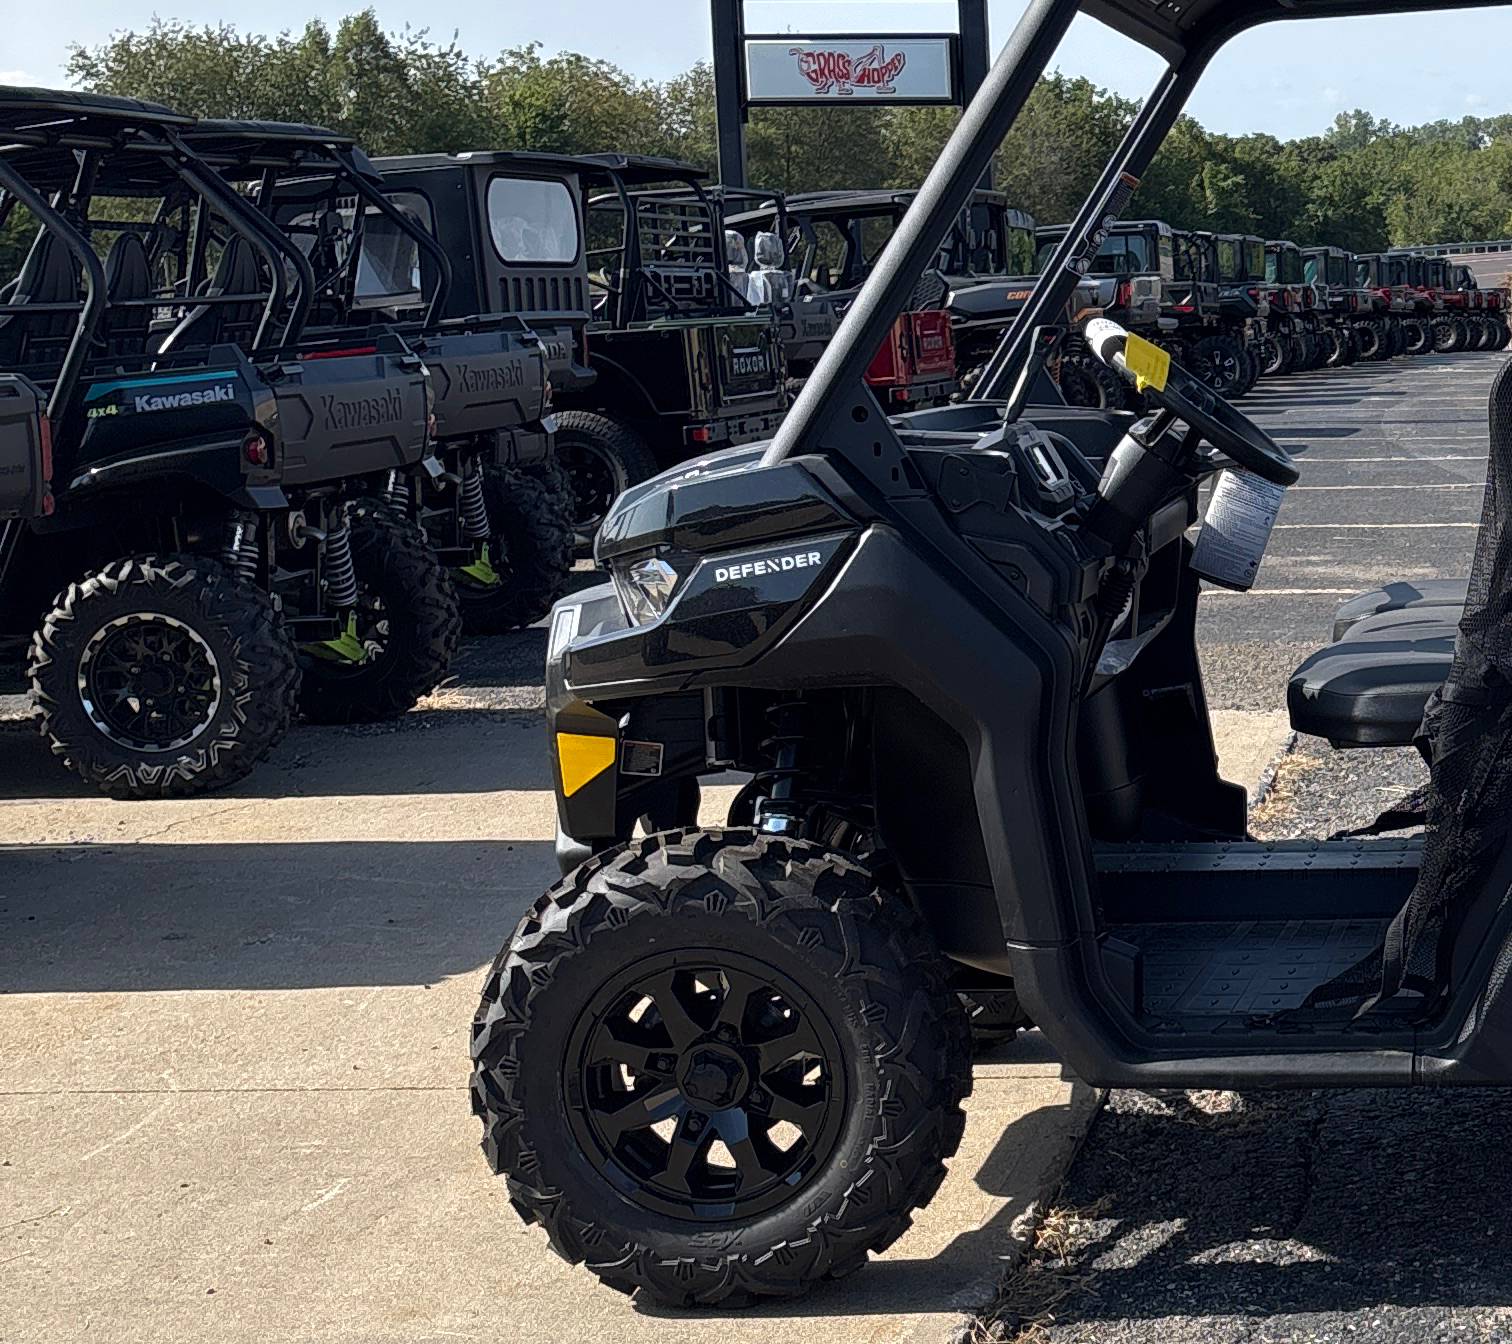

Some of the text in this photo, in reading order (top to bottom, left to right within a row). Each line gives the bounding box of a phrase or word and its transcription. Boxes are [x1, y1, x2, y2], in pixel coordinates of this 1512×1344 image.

[456, 359, 524, 393] Kawasaki
[732, 355, 766, 375] ROXOR
[86, 403, 119, 419] 4x4
[134, 383, 235, 413] Kawasaki
[320, 388, 403, 431] Kawasaki
[715, 551, 822, 583] DEFENDER
